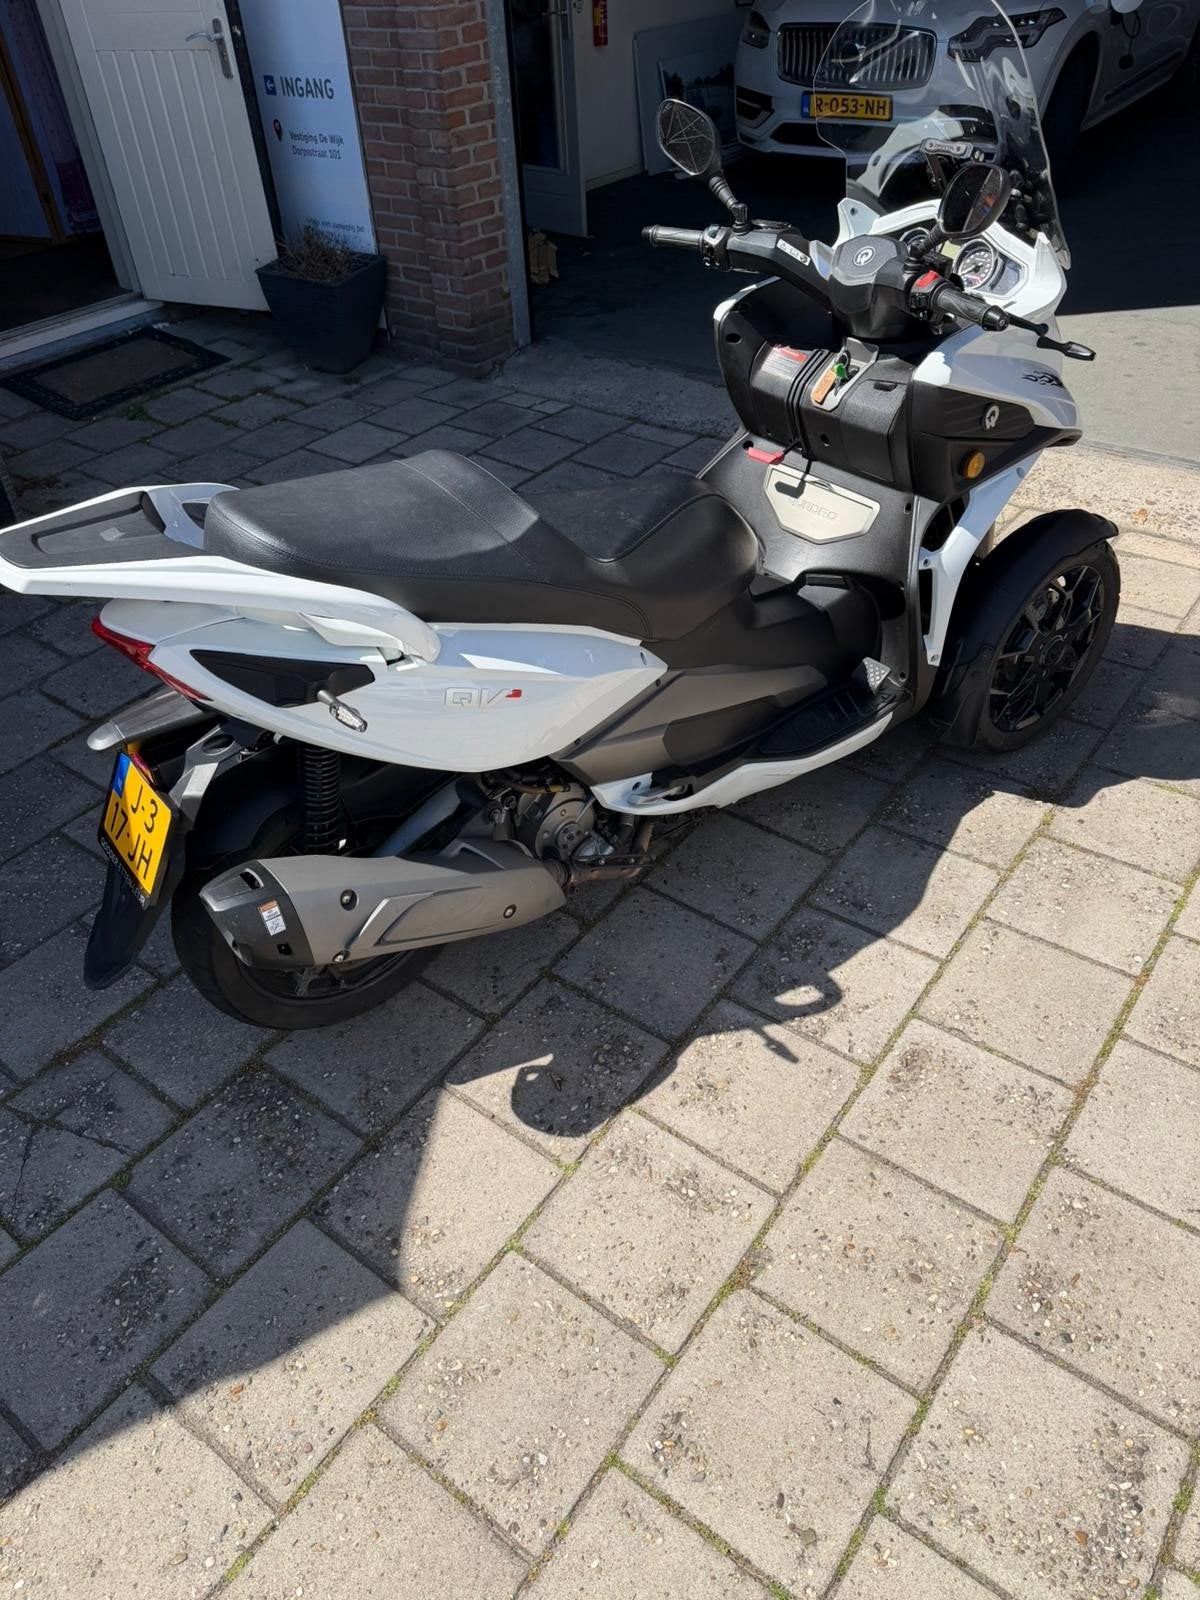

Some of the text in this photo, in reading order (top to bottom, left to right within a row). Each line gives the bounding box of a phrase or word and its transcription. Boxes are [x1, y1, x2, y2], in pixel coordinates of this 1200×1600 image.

[280, 76, 334, 99] INGANG
[815, 97, 887, 116] R-053-NH
[289, 130, 344, 146] Vestiging De Wijk
[328, 149, 342, 160] 101
